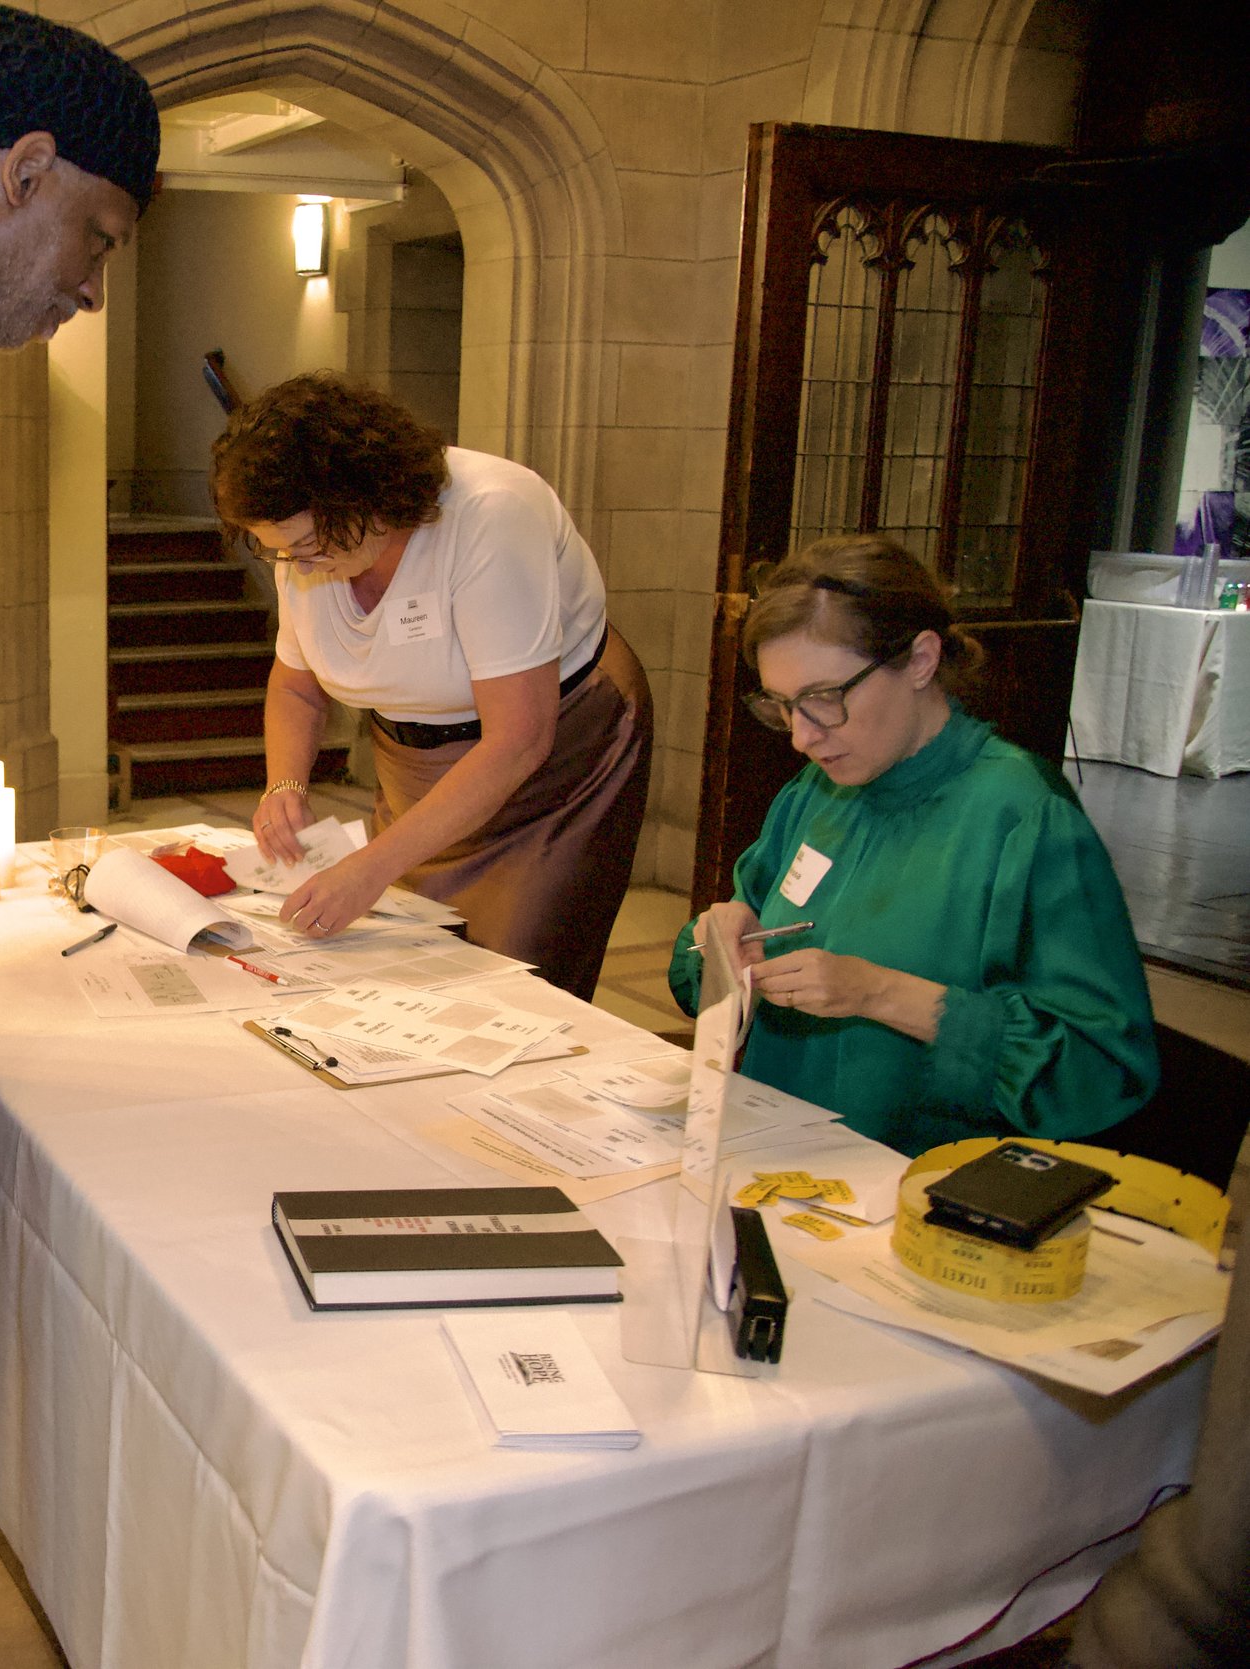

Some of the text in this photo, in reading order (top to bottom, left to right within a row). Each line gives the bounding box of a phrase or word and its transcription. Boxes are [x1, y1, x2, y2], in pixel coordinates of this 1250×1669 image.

[400, 614, 428, 625] Maureen
[611, 1128, 645, 1144] Richard
[941, 1266, 987, 1290] TICKET
[1013, 1281, 1055, 1296] TICKET
[516, 1353, 552, 1385] HOPE
[538, 1354, 566, 1384] RISING
